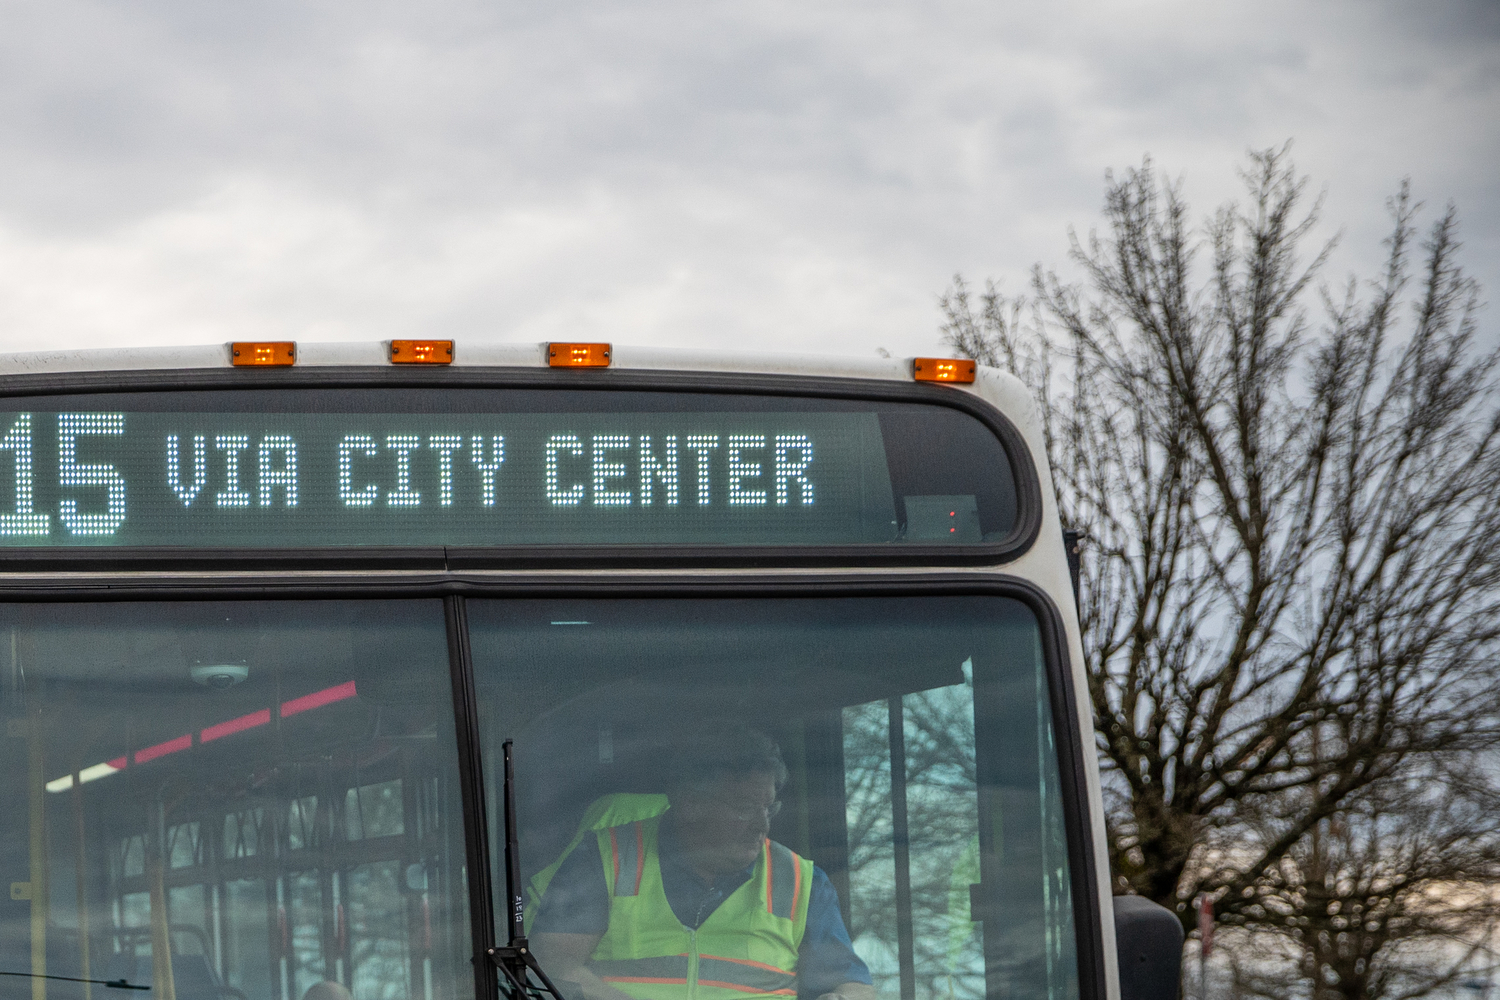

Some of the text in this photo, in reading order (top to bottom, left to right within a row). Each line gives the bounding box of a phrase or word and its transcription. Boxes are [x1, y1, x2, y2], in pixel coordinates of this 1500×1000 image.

[0, 413, 814, 536] 15 VIA CITY CENTER
